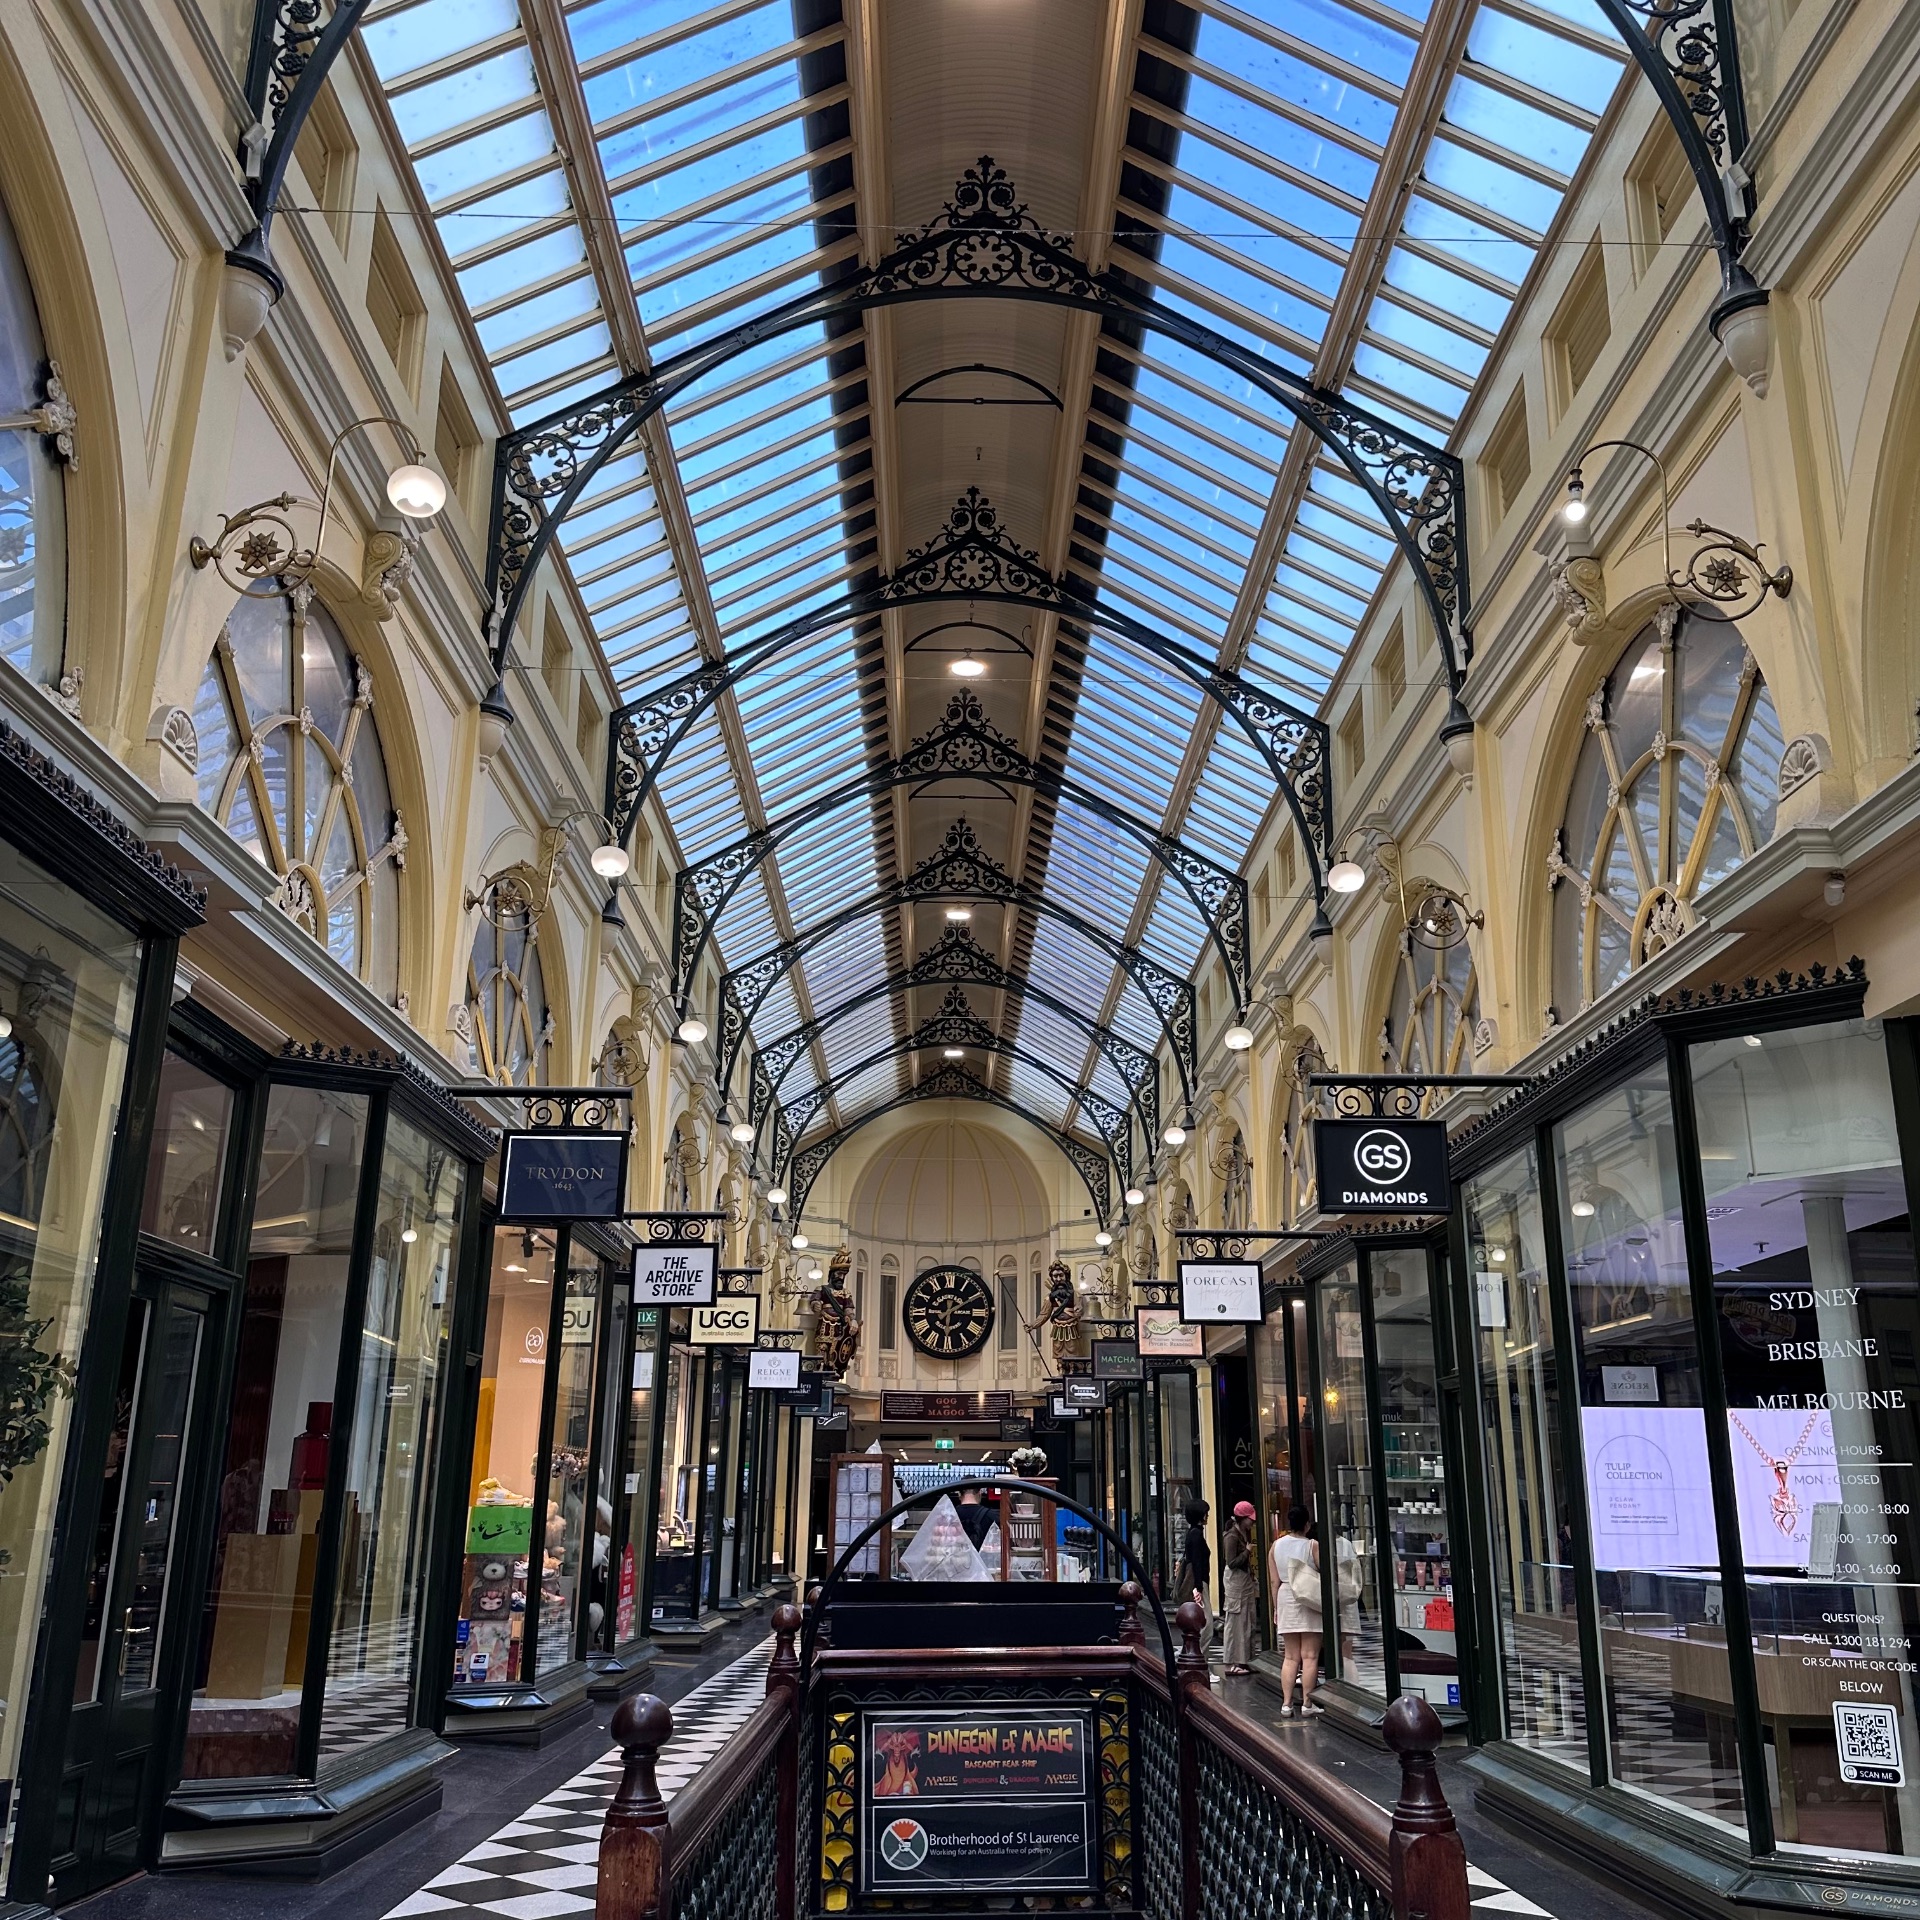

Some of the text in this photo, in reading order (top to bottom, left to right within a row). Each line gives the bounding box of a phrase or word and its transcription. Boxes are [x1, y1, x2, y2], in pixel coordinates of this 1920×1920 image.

[1361, 1144, 1402, 1169] GS
[1342, 1192, 1428, 1204] DIAMONDS
[662, 1256, 689, 1270] THE
[644, 1270, 704, 1283] ARCHIVE
[1185, 1276, 1255, 1286] FORECAST
[652, 1284, 696, 1296] STORE
[1769, 1287, 1861, 1311] SYDNEY
[698, 1310, 750, 1329] UGG
[1767, 1338, 1879, 1361] BRISBANE
[1756, 1390, 1906, 1412] MELBOURNE
[1381, 1412, 1402, 1422] muk
[1840, 1446, 1883, 1456] HOURS
[1605, 1463, 1631, 1471] TULIP
[1606, 1472, 1663, 1480] COLLECTION
[1794, 1475, 1823, 1485] MON
[1833, 1475, 1880, 1485] CLOSED
[1838, 1504, 1868, 1514] 10:00
[1878, 1504, 1909, 1514] 18:00
[1866, 1535, 1898, 1544] 17:00
[1868, 1564, 1901, 1574] 16:00
[1822, 1612, 1885, 1624] QUESTIONS?
[1802, 1634, 1911, 1648] CALL 1300 181 294
[1802, 1657, 1918, 1672] OR SCAN THE QR CODE
[1840, 1680, 1883, 1694] BELOW
[928, 1727, 1074, 1755] DUNGEON of MAGIC
[964, 1759, 1038, 1769] BASEMENT REAR SHOP
[924, 1775, 958, 1786] MAGIC
[999, 1775, 1009, 1785] &
[1044, 1773, 1078, 1785] MAGIC
[1860, 1771, 1880, 1780] SCAN
[929, 1832, 1000, 1846] Brotherhood
[1001, 1832, 1014, 1844] of
[1029, 1832, 1080, 1844] Laurence
[929, 1848, 957, 1857] Working
[1824, 1891, 1844, 1901] GS
[1852, 1892, 1918, 1907] DIAMONDS
